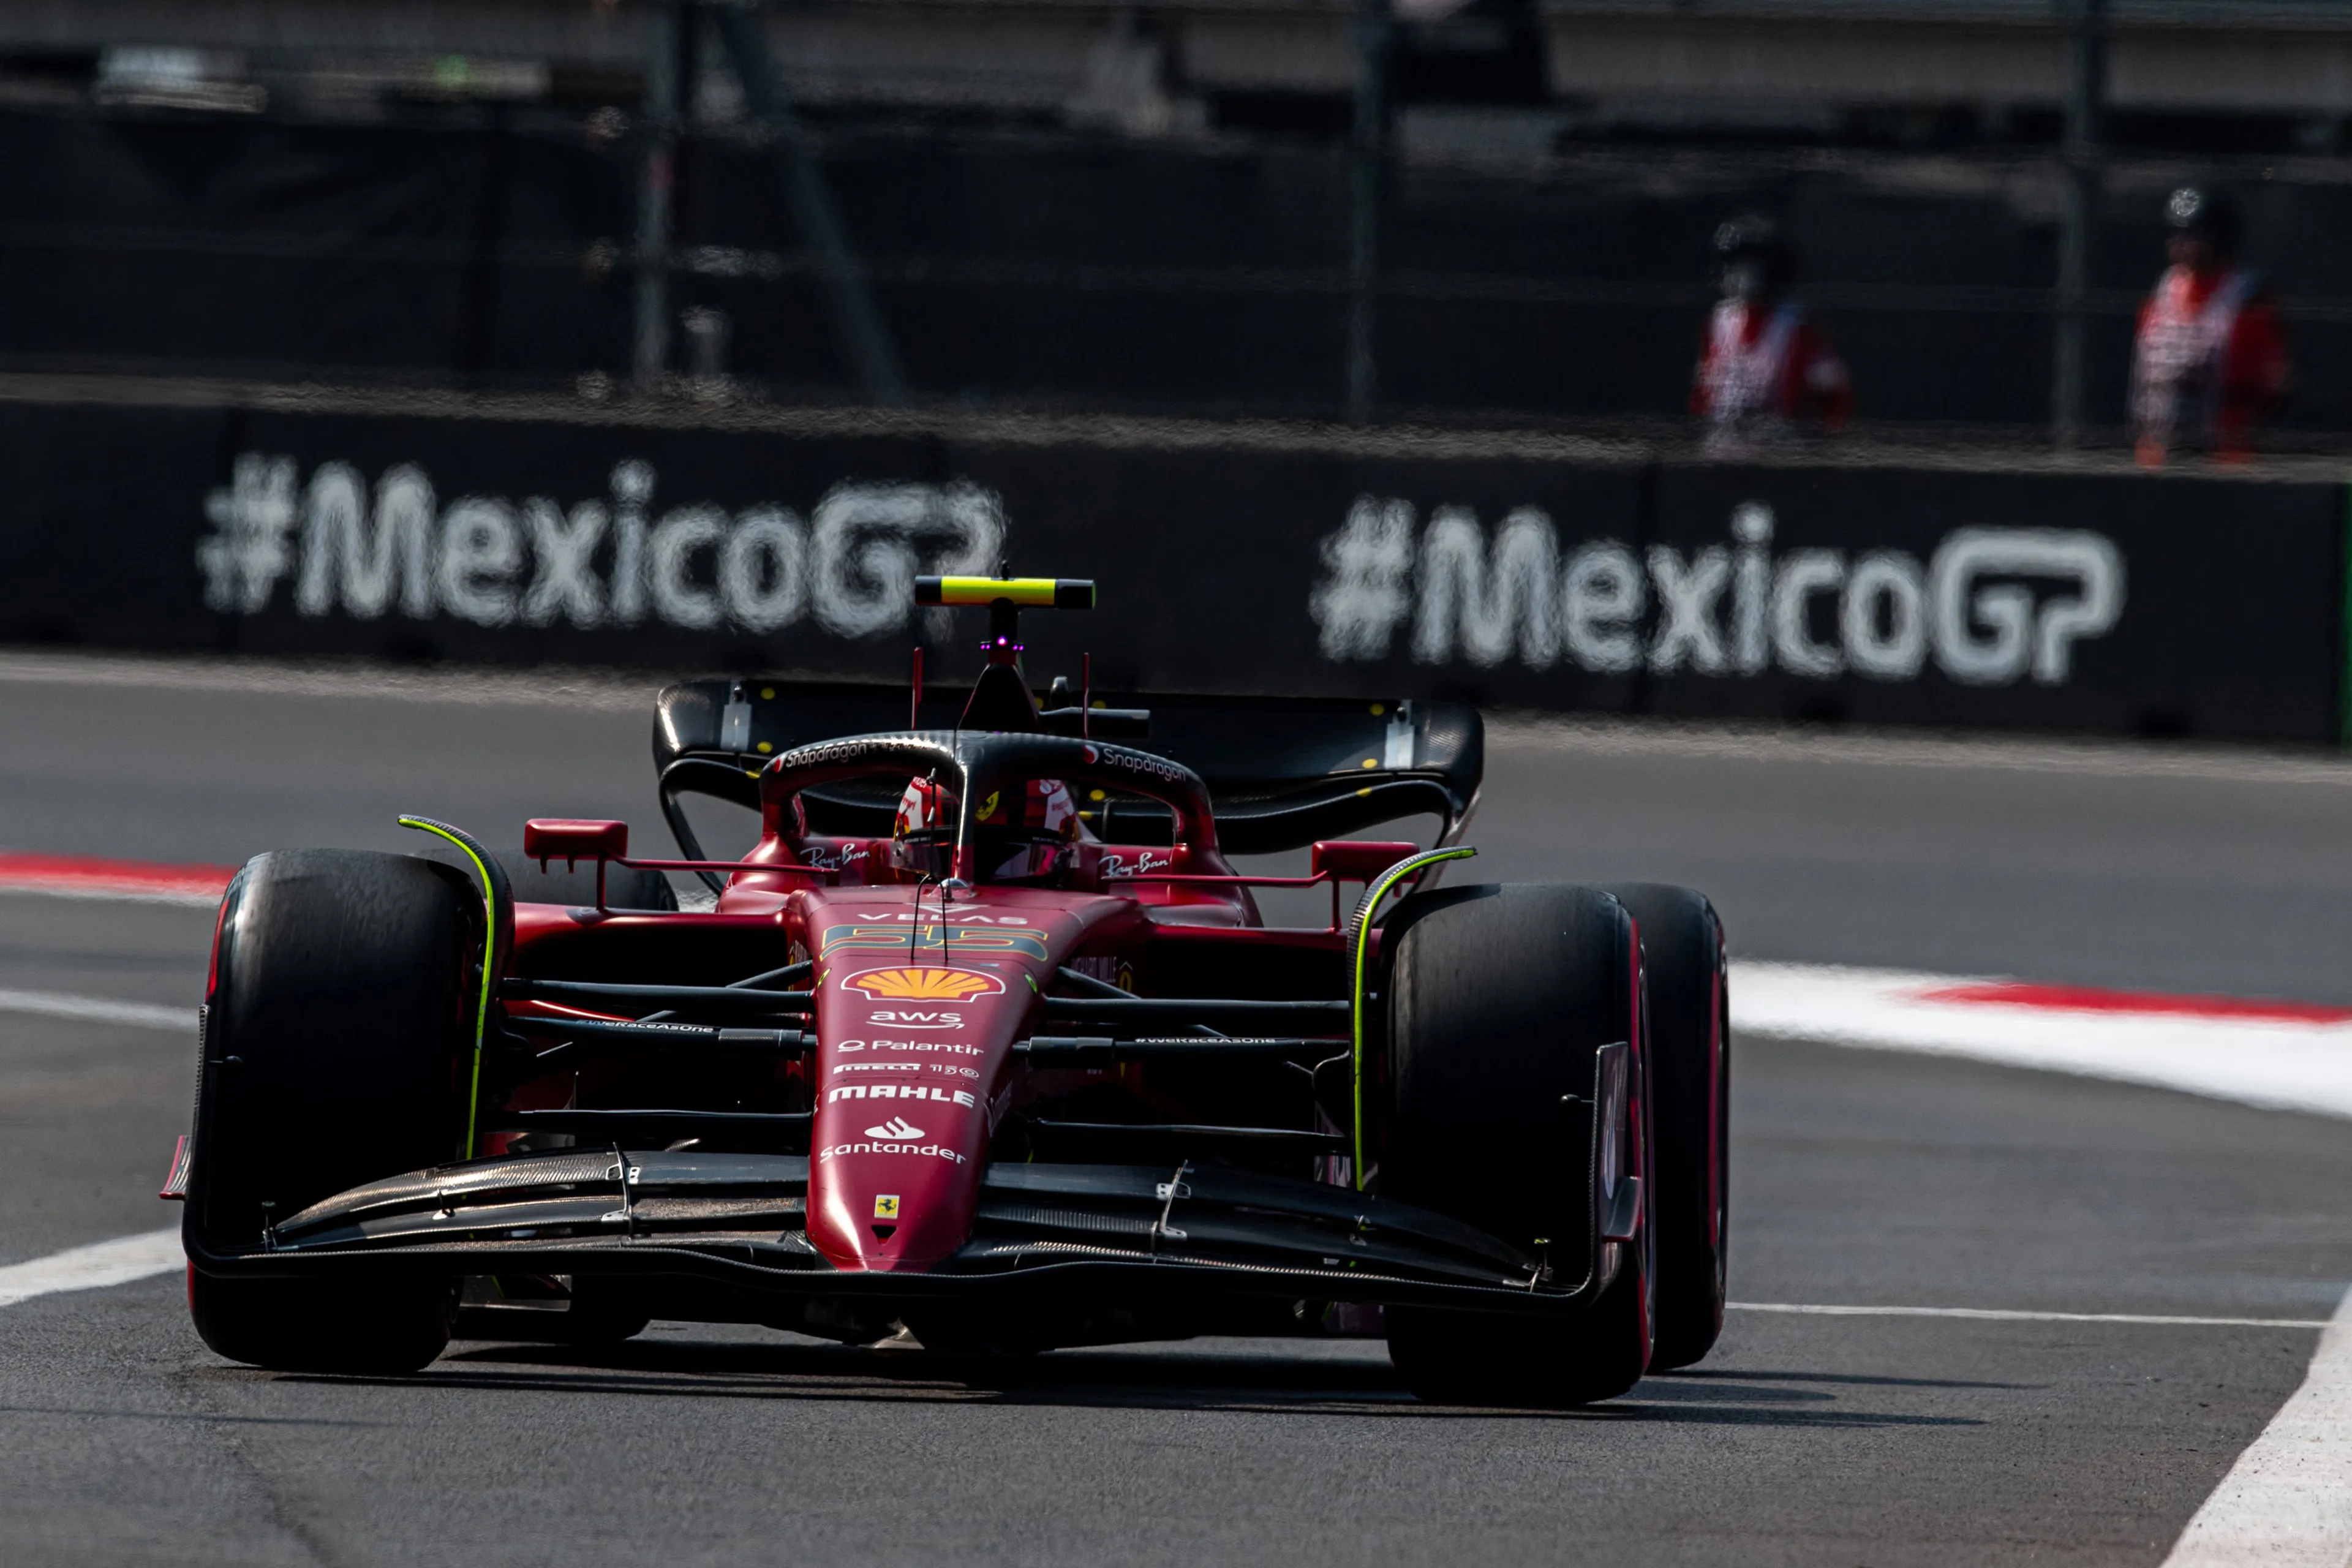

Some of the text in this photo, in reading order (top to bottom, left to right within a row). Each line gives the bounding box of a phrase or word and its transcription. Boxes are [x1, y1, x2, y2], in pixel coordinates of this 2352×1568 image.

[197, 452, 1005, 641] #MexicoGP
[1310, 494, 2127, 685] #MexicoGP
[786, 743, 867, 768] Snapdragon
[1103, 747, 1186, 782] Snapdragon
[799, 843, 870, 872] Ray-Ban
[1098, 852, 1169, 878] Ray-Ban
[857, 913, 1028, 925] VELAS
[820, 924, 1049, 962] 55
[870, 1011, 962, 1022] aws
[872, 1040, 984, 1056] Palantir
[832, 1063, 921, 1074] PIRELLI
[828, 1085, 975, 1109] MAHLE
[820, 1141, 967, 1164] Santander
